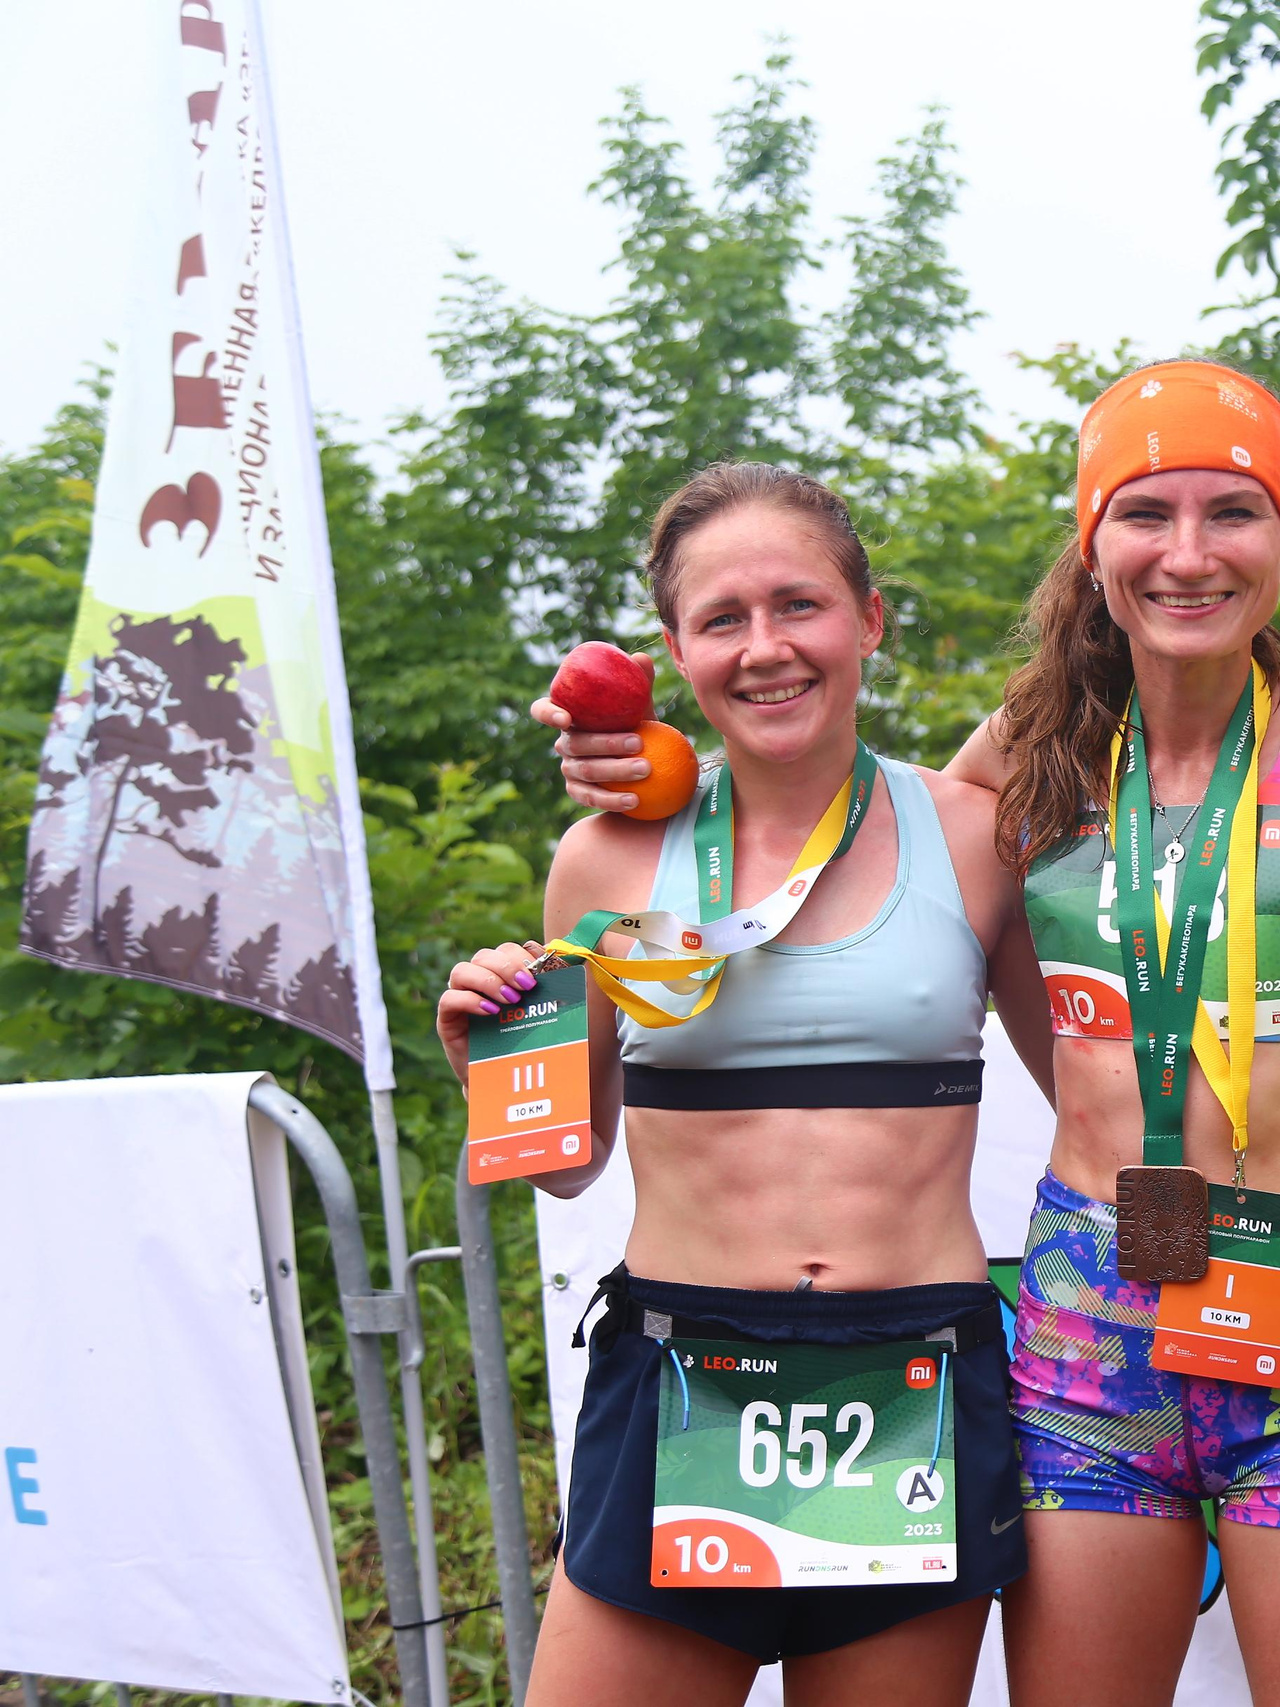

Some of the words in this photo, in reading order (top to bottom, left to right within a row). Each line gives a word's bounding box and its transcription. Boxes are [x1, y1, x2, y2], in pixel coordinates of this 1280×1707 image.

[1130, 807, 1141, 892] #БЕГУКАКЛЕОПАРД
[1199, 807, 1227, 867] LEO.RUN
[708, 846, 722, 904] LEO.RUN
[1132, 929, 1150, 993] LEO.RUN
[1176, 904, 1198, 994] #БЕГУКАКЛЕОПАРД
[500, 1000, 559, 1024] LEO.RUN
[1058, 988, 1096, 1025] 10
[1099, 1016, 1115, 1026] km
[513, 1062, 545, 1093] III
[1161, 1033, 1179, 1097] LEO.RUN
[515, 1106, 527, 1117] 10
[529, 1104, 544, 1115] KM
[1210, 1312, 1223, 1321] 10
[1225, 1314, 1242, 1325] KM
[703, 1356, 778, 1374] LEO.RUN
[738, 1400, 874, 1489] 652
[907, 1472, 937, 1506] A
[904, 1523, 943, 1537] 2023
[674, 1535, 729, 1574] 10
[733, 1563, 752, 1574] km
[798, 1565, 849, 1573] RUNDNSRUN
